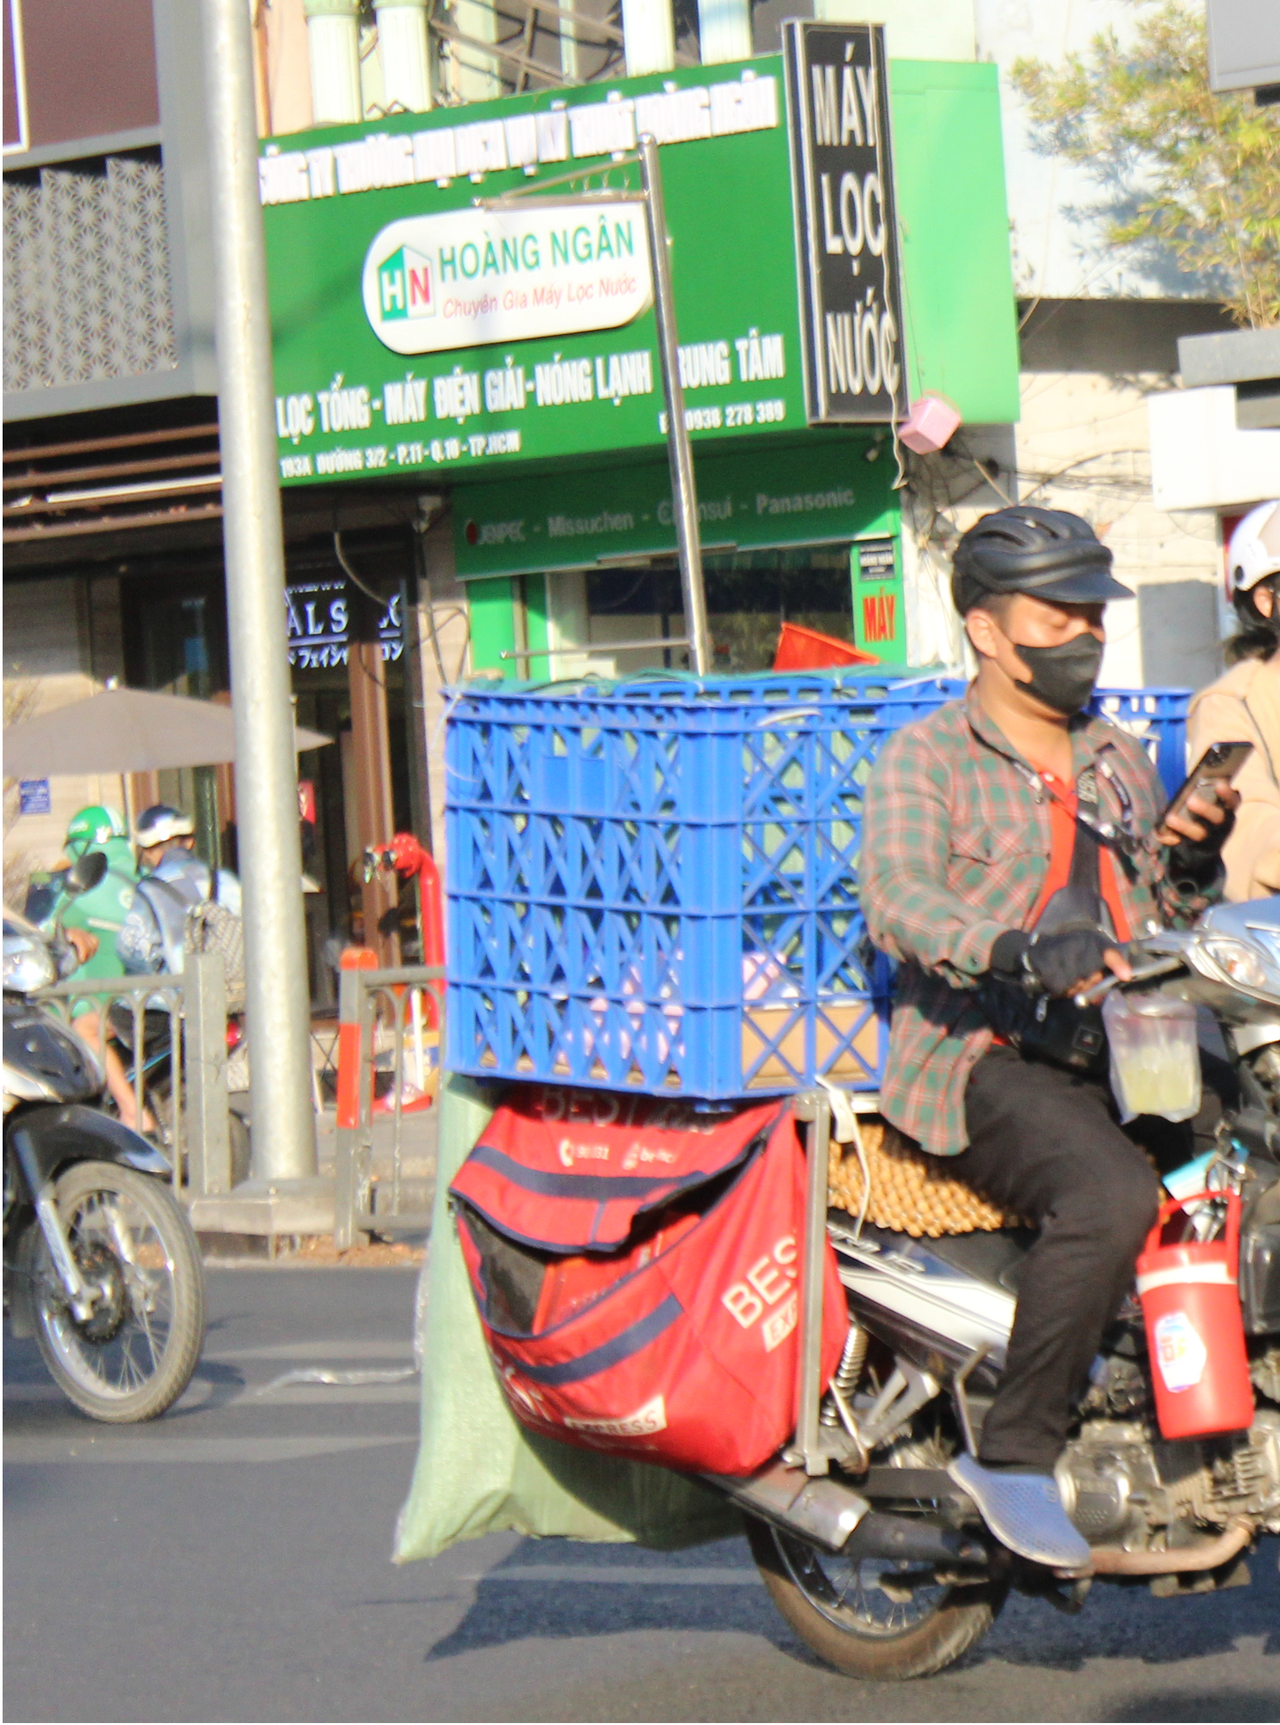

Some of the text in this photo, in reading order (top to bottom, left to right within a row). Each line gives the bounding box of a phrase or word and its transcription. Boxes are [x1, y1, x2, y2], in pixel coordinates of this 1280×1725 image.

[810, 42, 878, 147] MÁY
[438, 214, 634, 283] HOÀNG NGÂN
[821, 172, 883, 276] LỌC
[503, 289, 528, 311] Gia
[533, 284, 562, 309] Máy
[567, 280, 595, 304] Lọc
[826, 286, 898, 395] NƯỚC
[275, 393, 316, 445] LỌC
[317, 371, 372, 433] TỔNG
[383, 371, 428, 426] MÁY
[433, 365, 481, 425] ĐIỆN
[595, 350, 654, 407] LẠNH
[676, 339, 732, 390] RUNG
[735, 325, 786, 382] TÂM
[316, 447, 364, 475] ĐƯỜNG
[365, 445, 388, 469] 3/2
[755, 486, 855, 516] Panasonic
[862, 586, 896, 642] MÁY
[721, 1235, 797, 1330] BES
